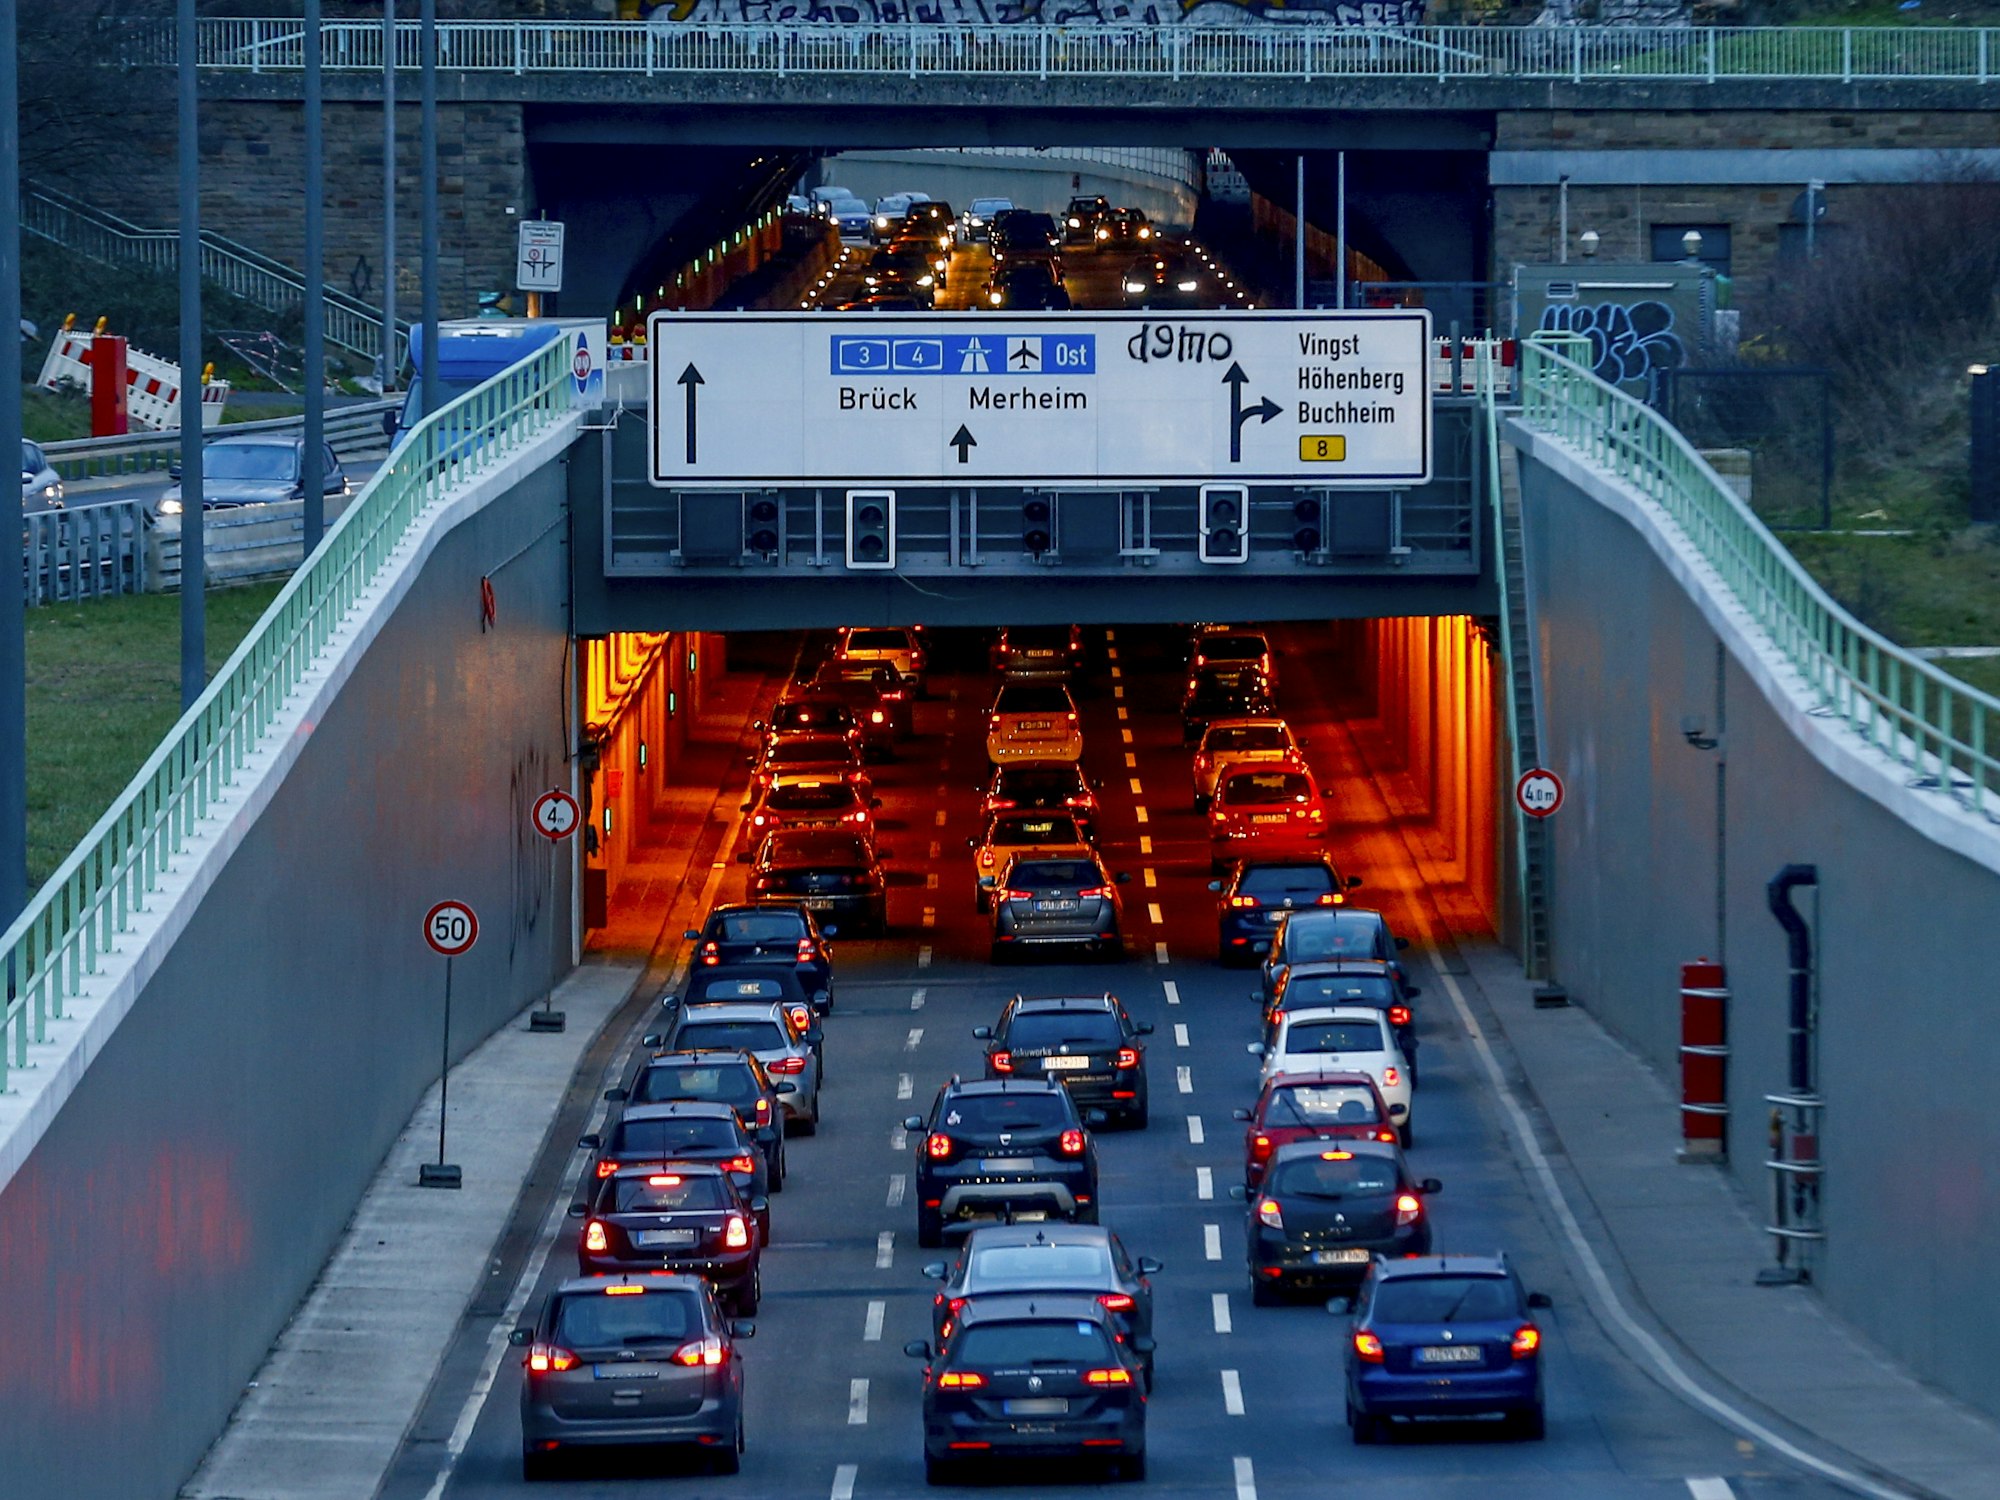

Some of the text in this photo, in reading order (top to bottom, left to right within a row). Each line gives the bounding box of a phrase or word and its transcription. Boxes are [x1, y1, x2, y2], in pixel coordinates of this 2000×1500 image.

[859, 343, 1087, 366] 3 4 Ost
[1298, 332, 1360, 361] Vingst
[1298, 366, 1404, 395] Höhenberg
[839, 386, 918, 410] Brück
[970, 386, 1088, 410] Merheim
[1298, 400, 1395, 423] Buchheim
[1317, 440, 1328, 457] 8
[547, 806, 557, 824] 4
[435, 916, 466, 942] 50
